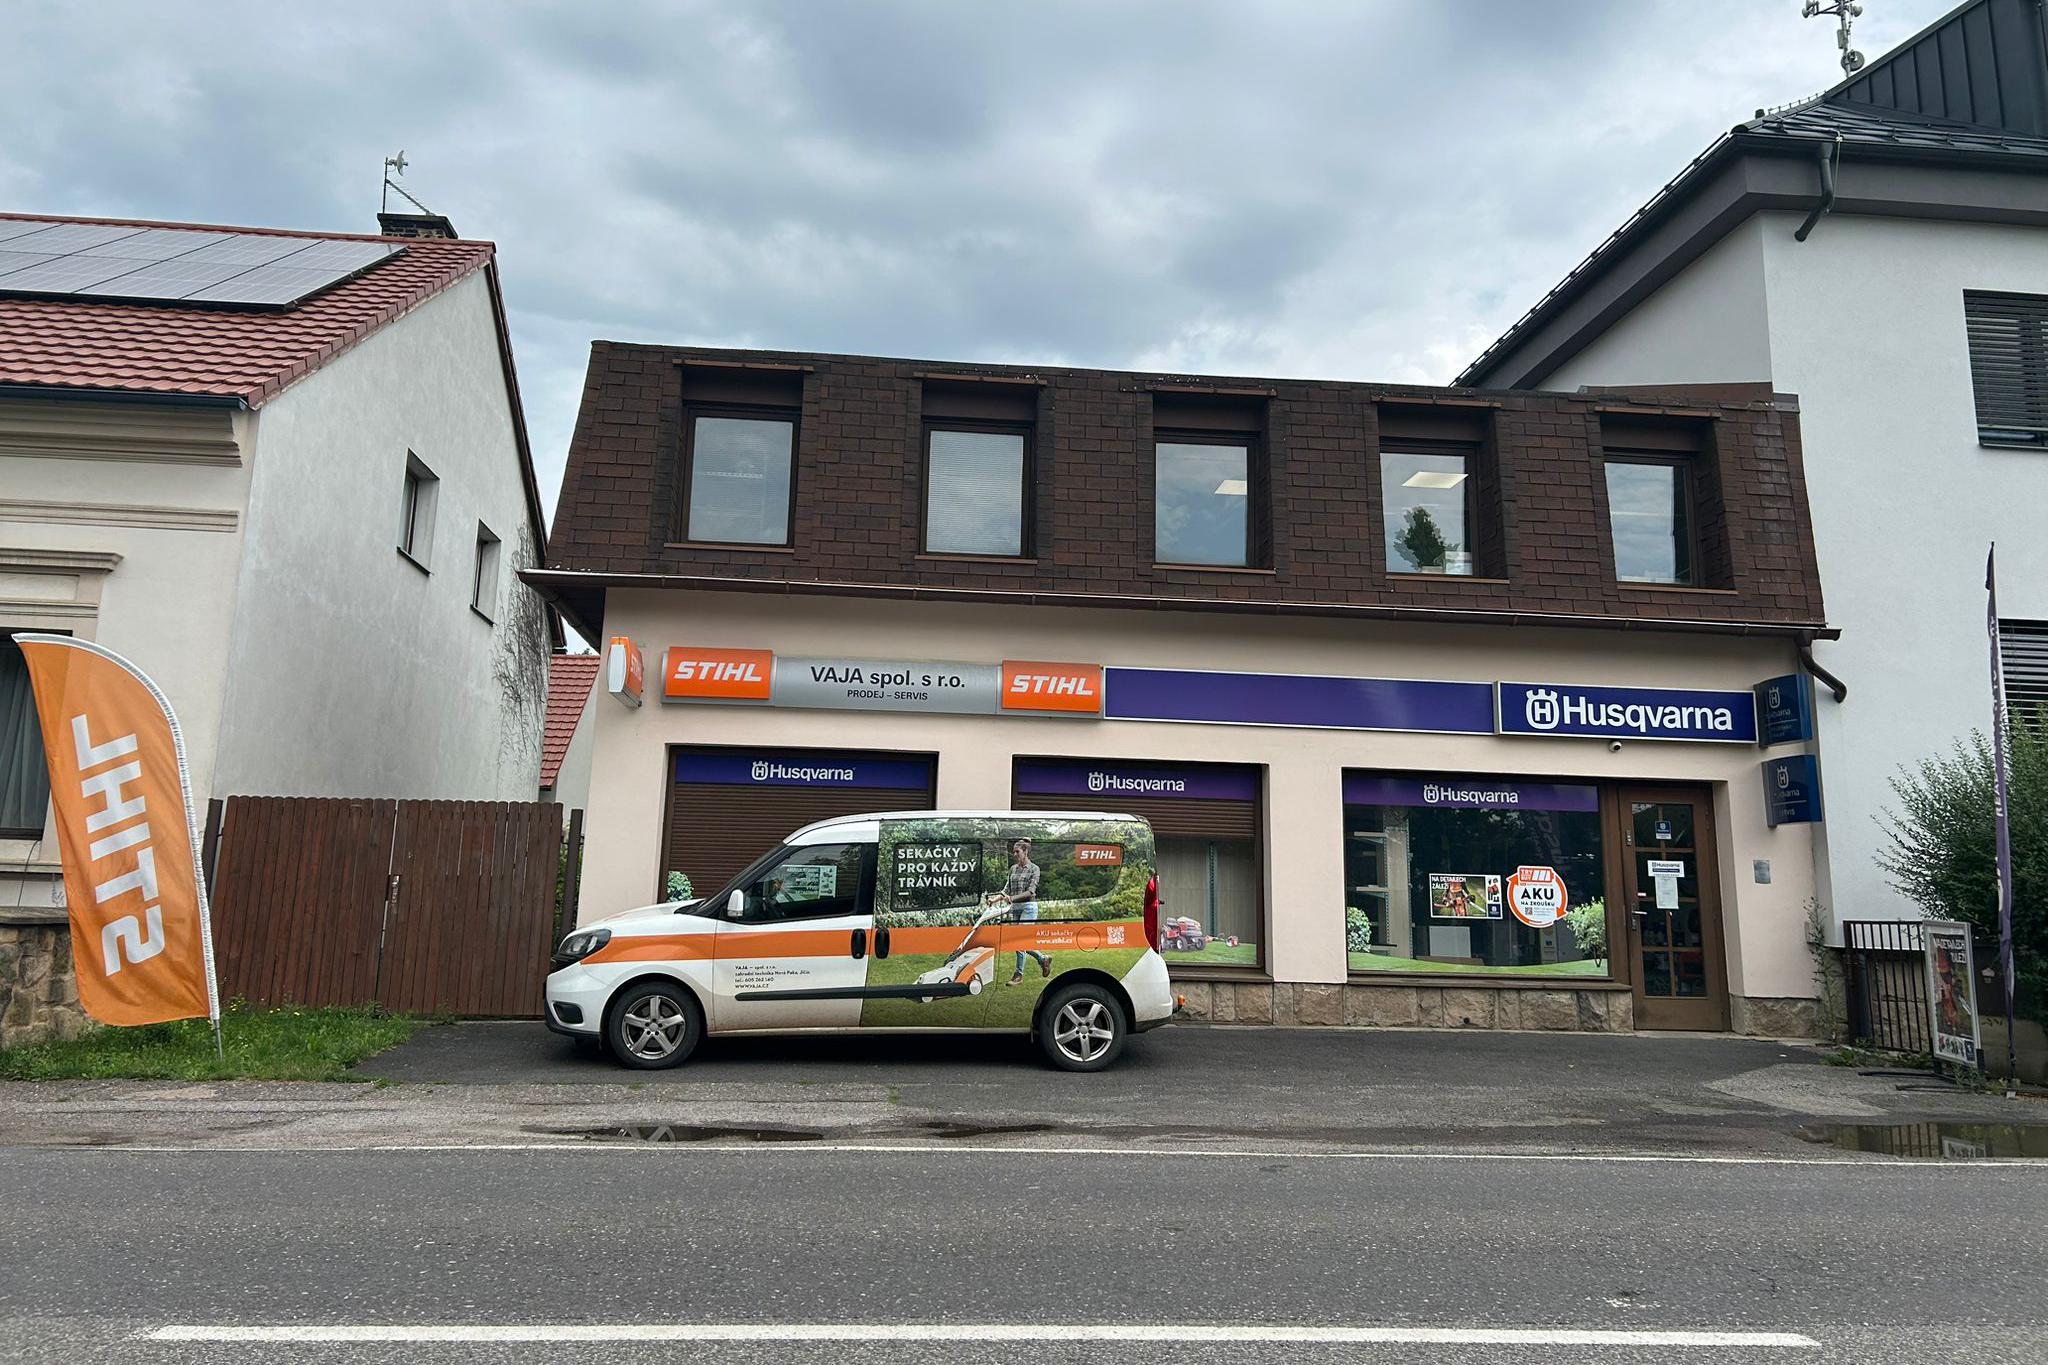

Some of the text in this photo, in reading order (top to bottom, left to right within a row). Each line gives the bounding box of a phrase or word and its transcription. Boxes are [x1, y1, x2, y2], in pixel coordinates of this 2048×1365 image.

[673, 660, 763, 683] STIHL
[810, 666, 966, 689] VAJA spol. s r.o.
[1010, 674, 1094, 697] STIHL
[847, 689, 885, 699] PRODEJ
[893, 691, 929, 701] SERVIS
[1563, 695, 1733, 733] Husqvarna
[769, 763, 855, 782] Husqvarna
[1105, 775, 1185, 792] Husqvarna
[1440, 787, 1519, 805] Husqvarna
[898, 847, 961, 860] SEKAČKY
[1080, 850, 1117, 860] STIHL
[898, 859, 977, 874] PRO KAŽDÝ
[898, 874, 957, 888] TRÁVNÍK
[1521, 888, 1554, 900] AKU
